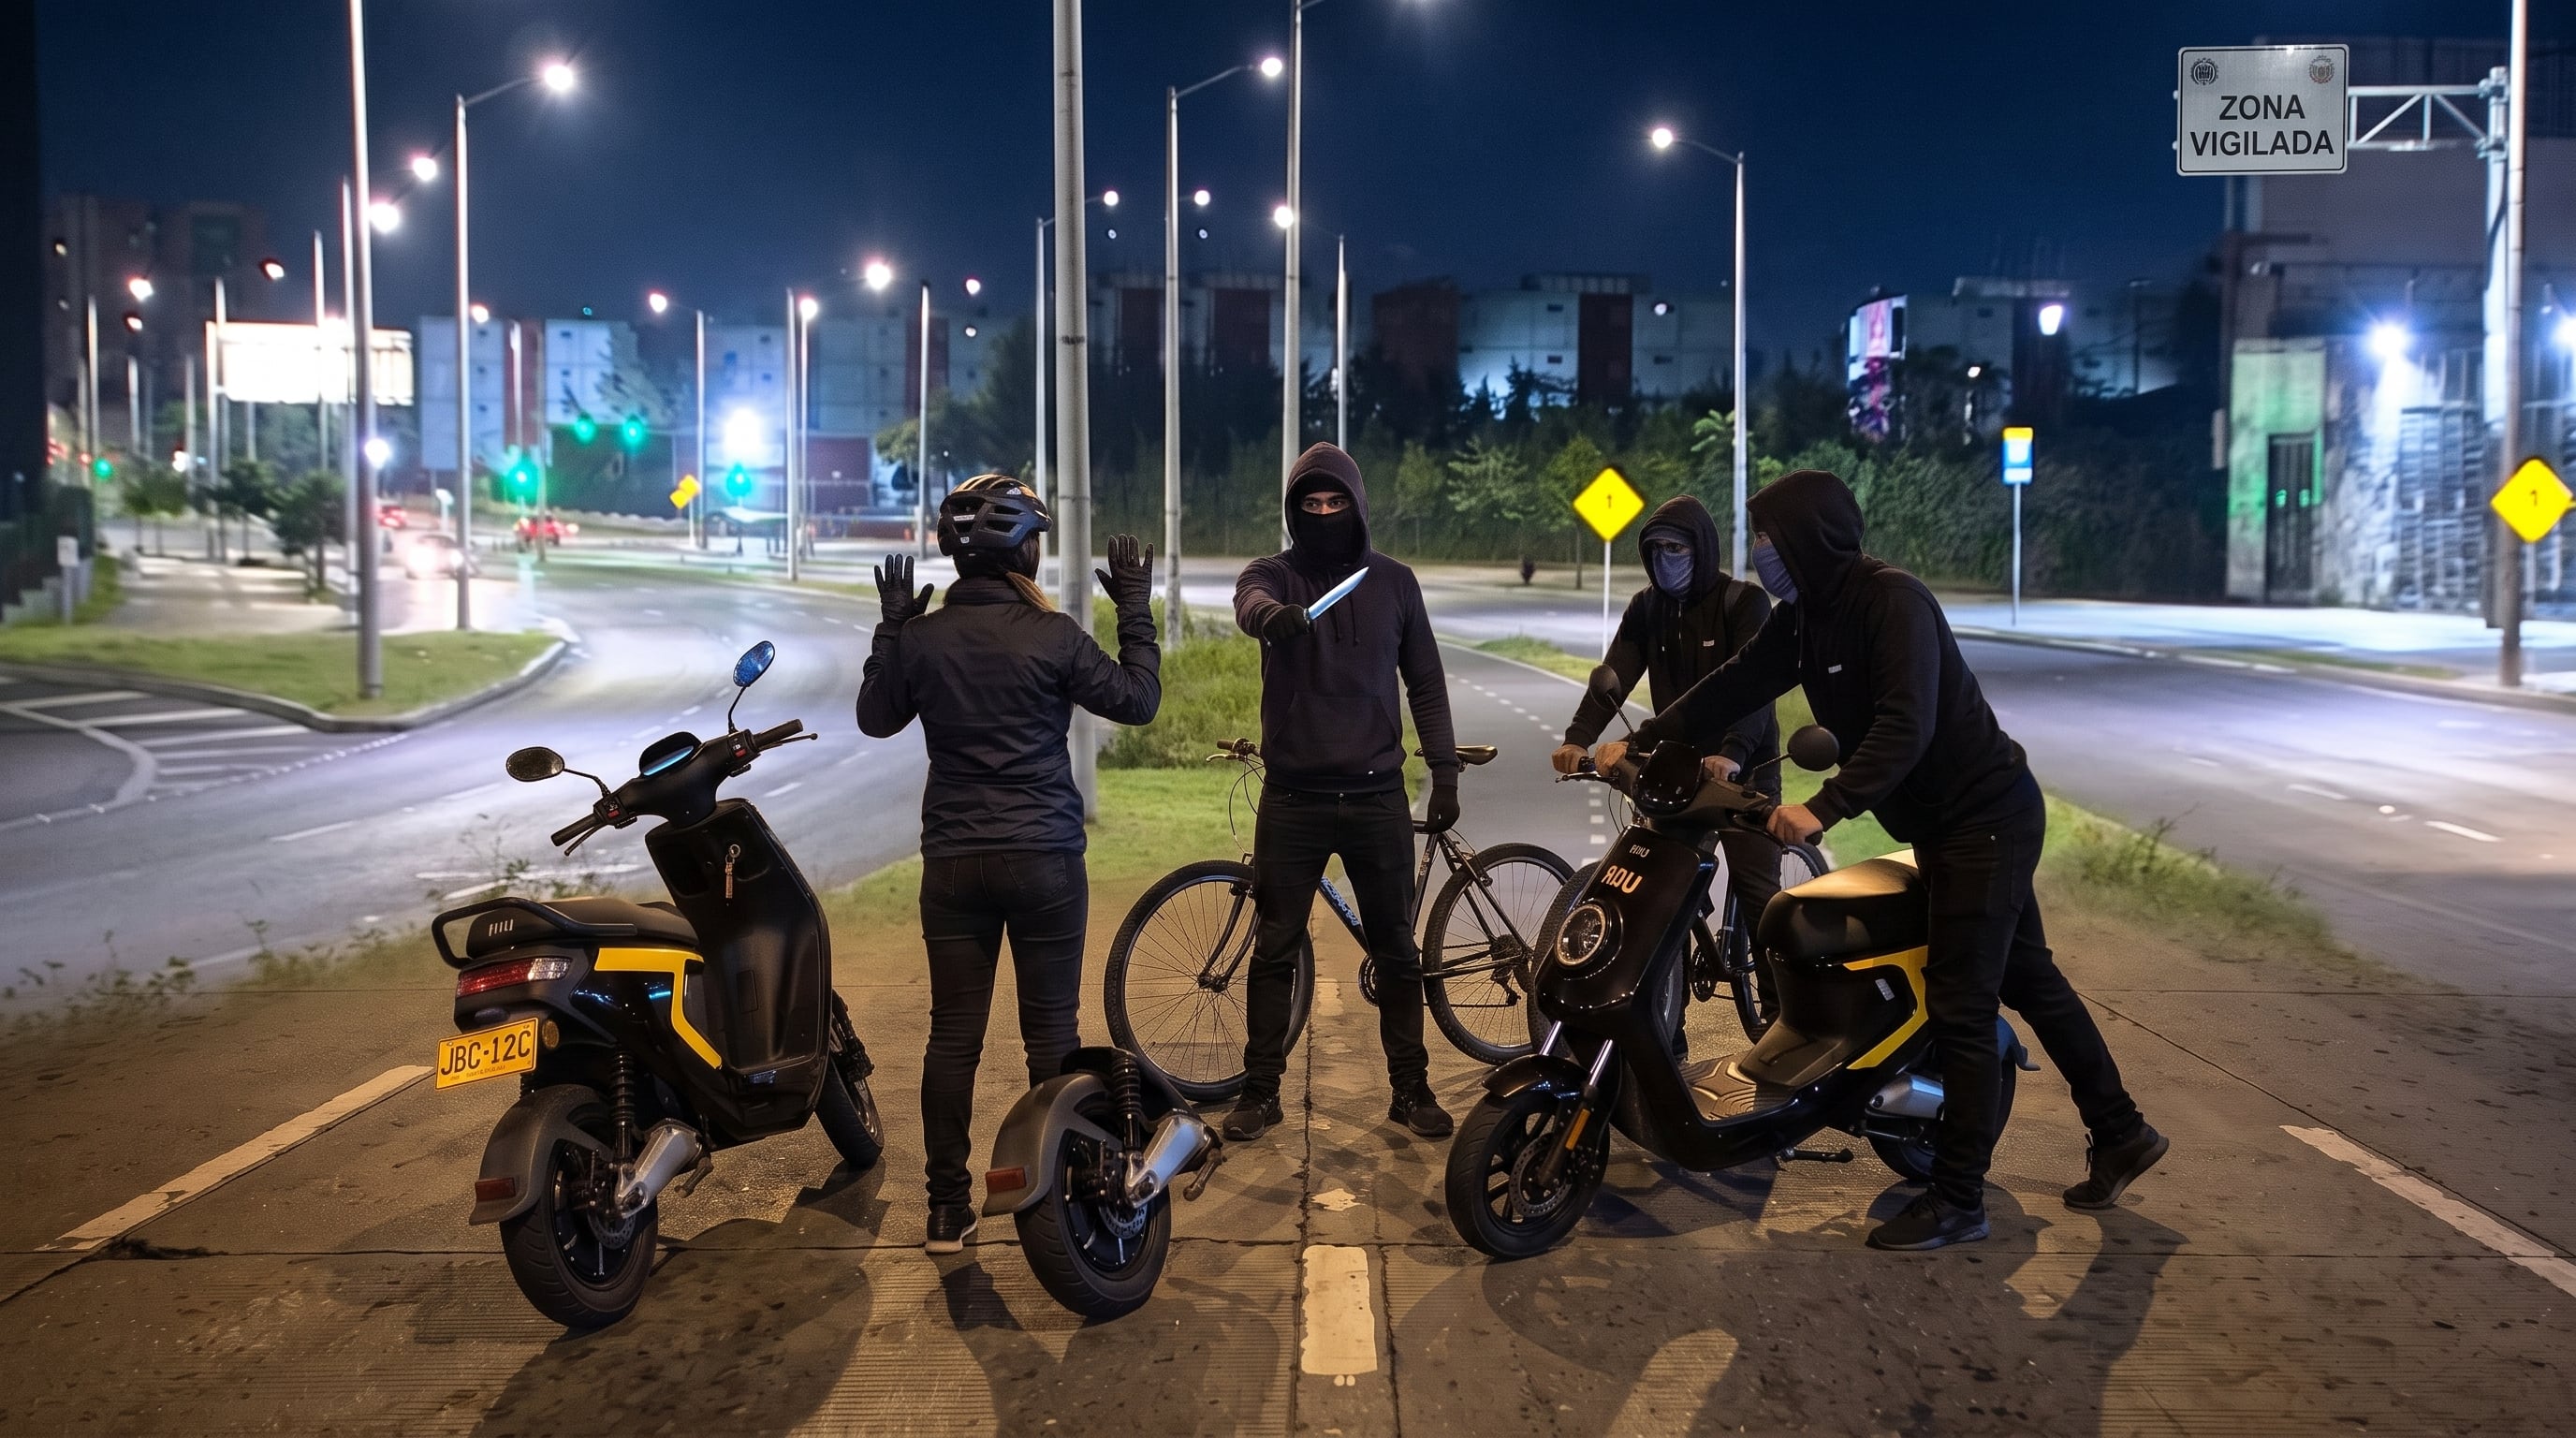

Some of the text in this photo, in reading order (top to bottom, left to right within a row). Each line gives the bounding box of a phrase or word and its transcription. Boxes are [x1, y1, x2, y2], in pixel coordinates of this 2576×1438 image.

[2219, 95, 2305, 120] ZONA
[2190, 130, 2334, 155] VIGILADA
[441, 1030, 531, 1075] JBC-12C
